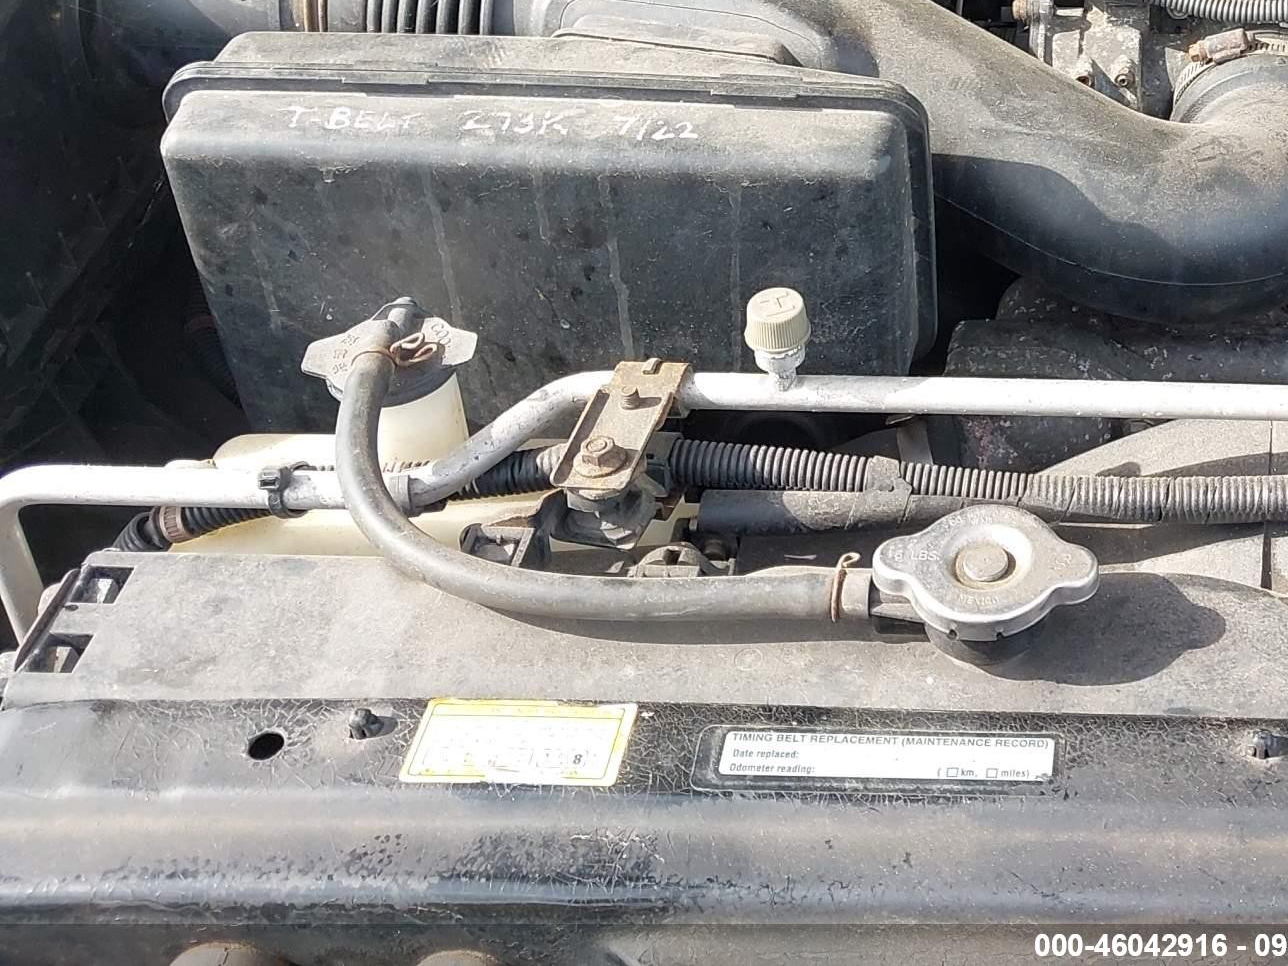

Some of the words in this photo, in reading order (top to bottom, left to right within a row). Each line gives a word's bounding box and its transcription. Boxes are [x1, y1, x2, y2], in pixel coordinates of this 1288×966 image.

[732, 733, 773, 743] TIMING
[776, 734, 807, 743] BELT
[810, 735, 899, 745] REPLACEMENT
[901, 736, 991, 747] (MAINTENANCE
[995, 738, 1049, 749] RECORD)
[733, 748, 754, 758] Date
[755, 749, 800, 761] replaced:
[730, 763, 777, 773] Odometer
[777, 764, 815, 776] reading:
